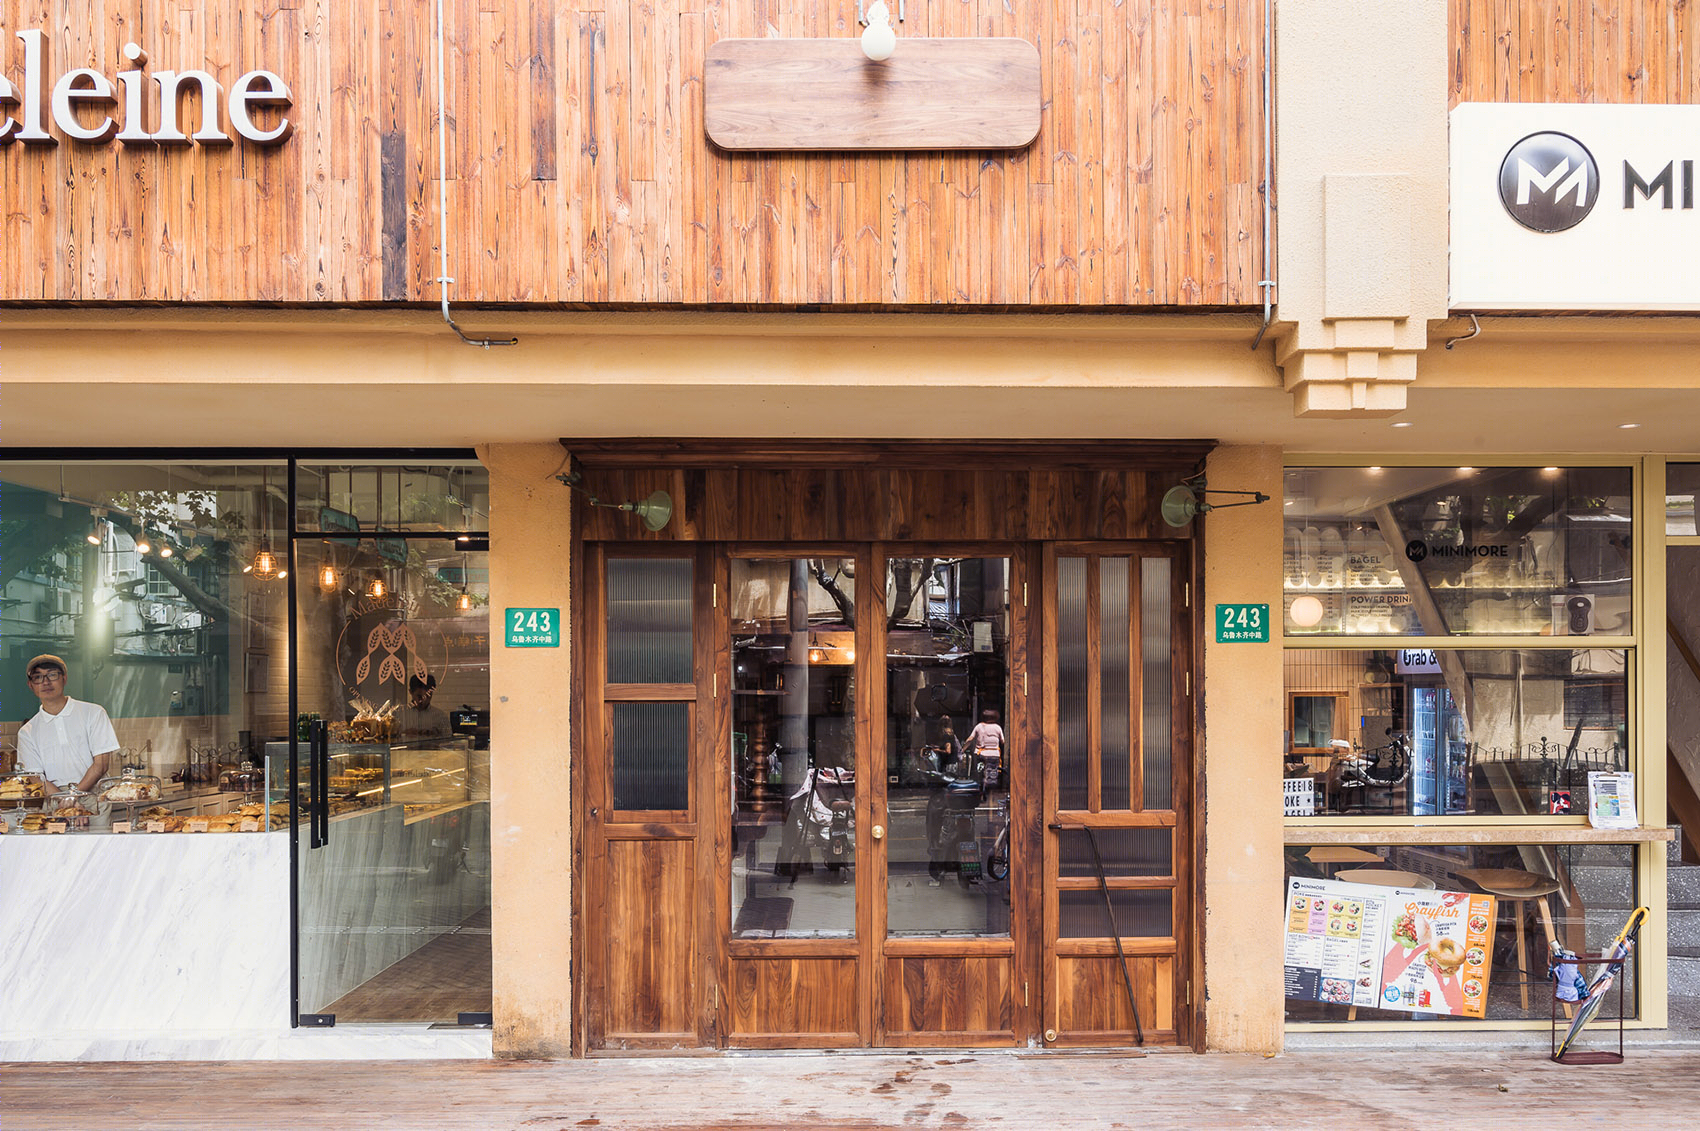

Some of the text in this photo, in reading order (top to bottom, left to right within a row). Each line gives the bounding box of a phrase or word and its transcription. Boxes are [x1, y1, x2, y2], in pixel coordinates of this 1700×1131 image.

[1622, 159, 1694, 209] MI
[1432, 545, 1508, 557] MINIMORE
[1350, 556, 1381, 564] BAGEL
[1350, 595, 1411, 604] POWER DRIN
[513, 611, 551, 632] 243
[1224, 607, 1261, 628] 243
[511, 635, 552, 643] 乌鲁木齐中路
[1222, 631, 1262, 639] 乌鲁木齐中路
[1403, 649, 1427, 667] Grab
[1404, 902, 1460, 920] Crayfish
